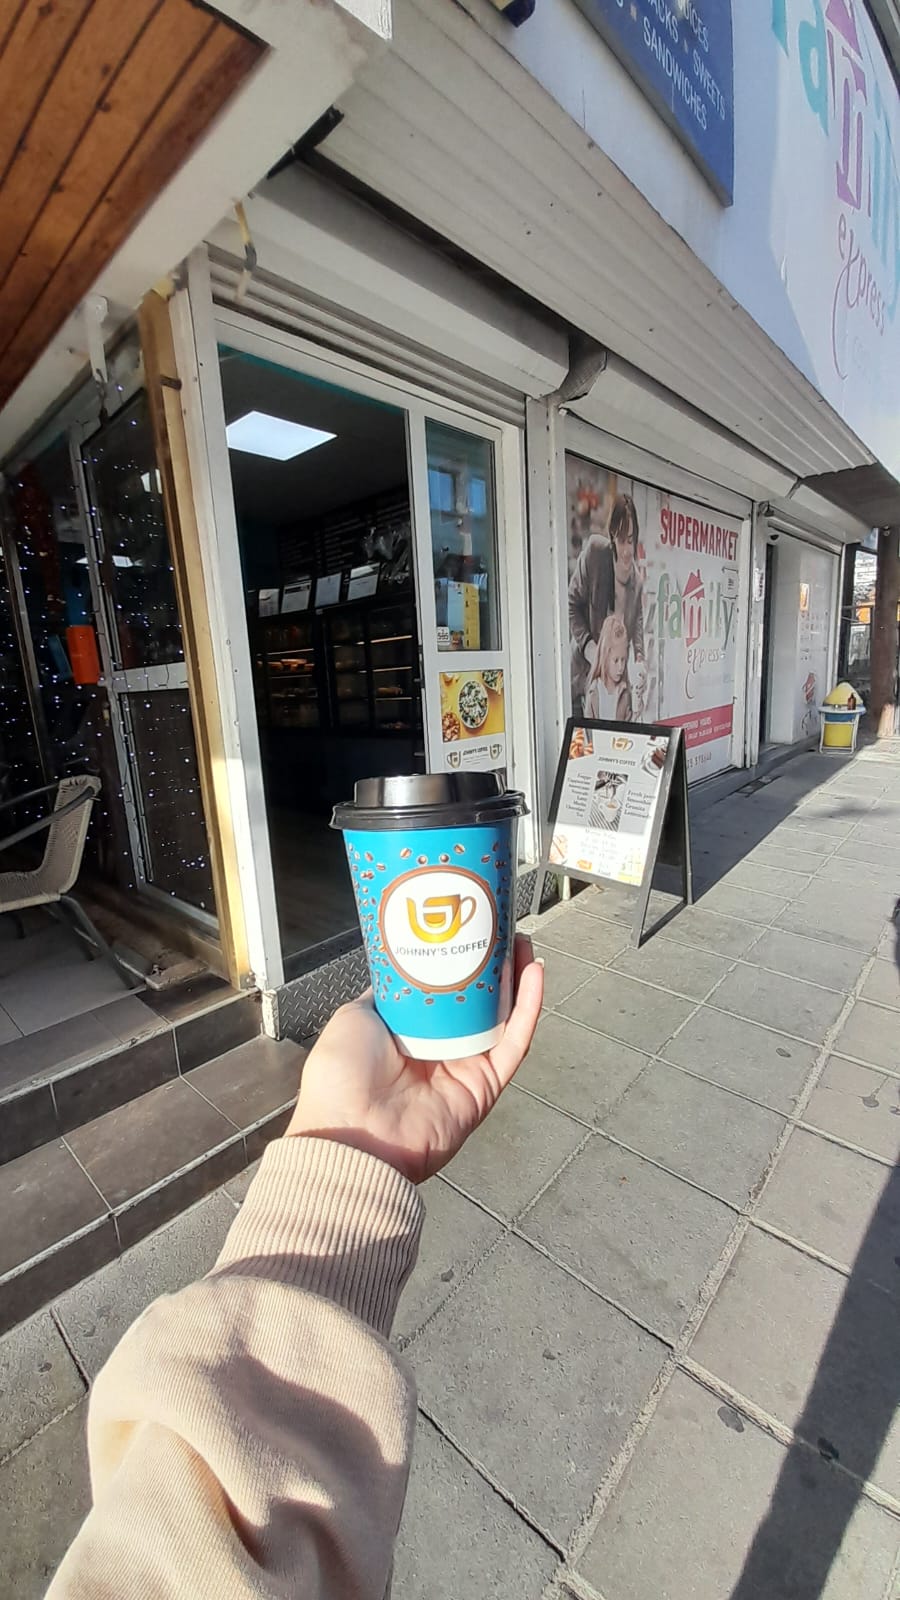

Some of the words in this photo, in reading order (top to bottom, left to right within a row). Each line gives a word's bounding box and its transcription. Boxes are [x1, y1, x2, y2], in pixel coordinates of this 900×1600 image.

[648, 0, 679, 43] ACKS
[678, 0, 709, 52] UICES
[643, 16, 707, 130] SANDWICHES
[693, 49, 726, 120] SWEETS
[660, 508, 739, 561] SUPERMARKET
[657, 570, 734, 650] family
[395, 945, 448, 957] JOHNNY'S
[451, 938, 488, 955] COFFEE
